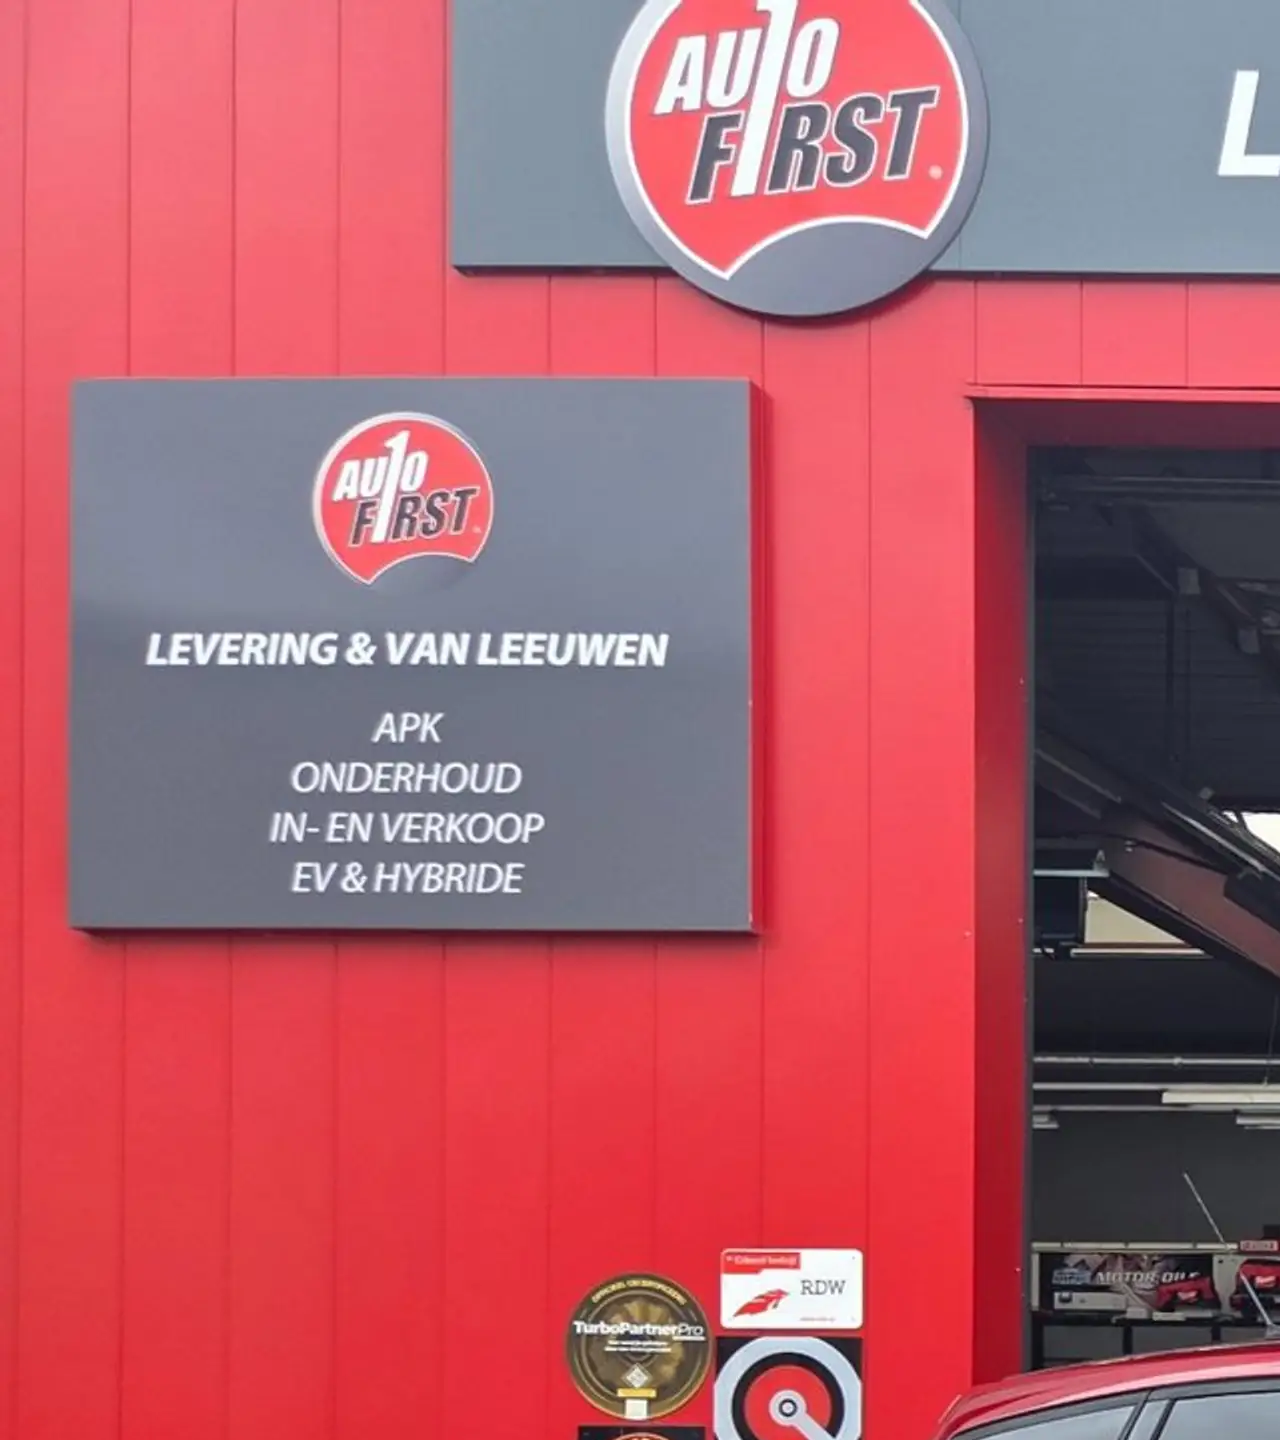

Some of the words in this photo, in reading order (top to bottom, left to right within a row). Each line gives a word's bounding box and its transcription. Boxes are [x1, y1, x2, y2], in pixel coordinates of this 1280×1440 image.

[685, 84, 940, 206] FIRST
[348, 485, 482, 548] FIRST
[146, 632, 339, 666] LEVERING
[345, 632, 377, 666] &
[385, 632, 471, 666] VAN
[476, 632, 670, 667] LEEUWEN
[371, 711, 444, 743] APK
[291, 761, 523, 794] ONDERHOUD
[269, 811, 320, 843] IN-
[325, 811, 374, 843] EN
[381, 811, 546, 844] VERKOOP
[291, 861, 338, 893] EV
[340, 861, 368, 893] &
[373, 861, 526, 894] HYBRIDE
[801, 1279, 846, 1296] RDW
